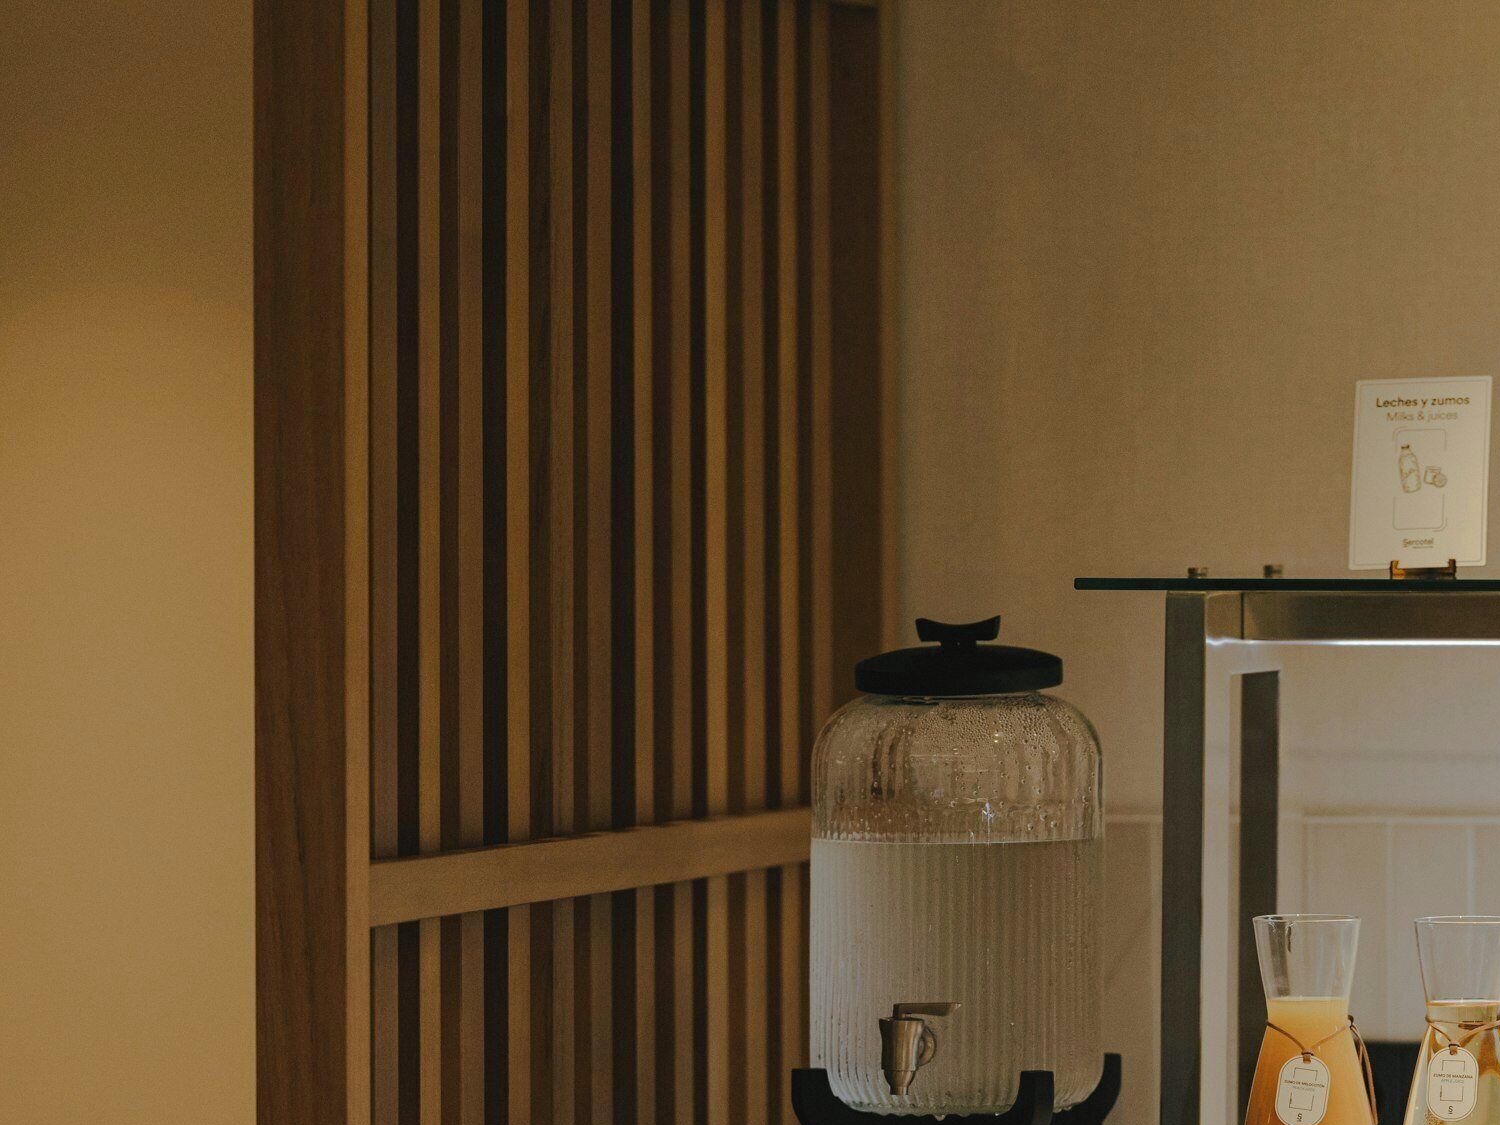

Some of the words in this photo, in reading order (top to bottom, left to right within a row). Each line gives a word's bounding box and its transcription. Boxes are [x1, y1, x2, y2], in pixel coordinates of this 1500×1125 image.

[1375, 396, 1418, 408] Leches
[1421, 399, 1428, 408] y
[1431, 397, 1470, 406] zumos
[1417, 410, 1425, 421] &
